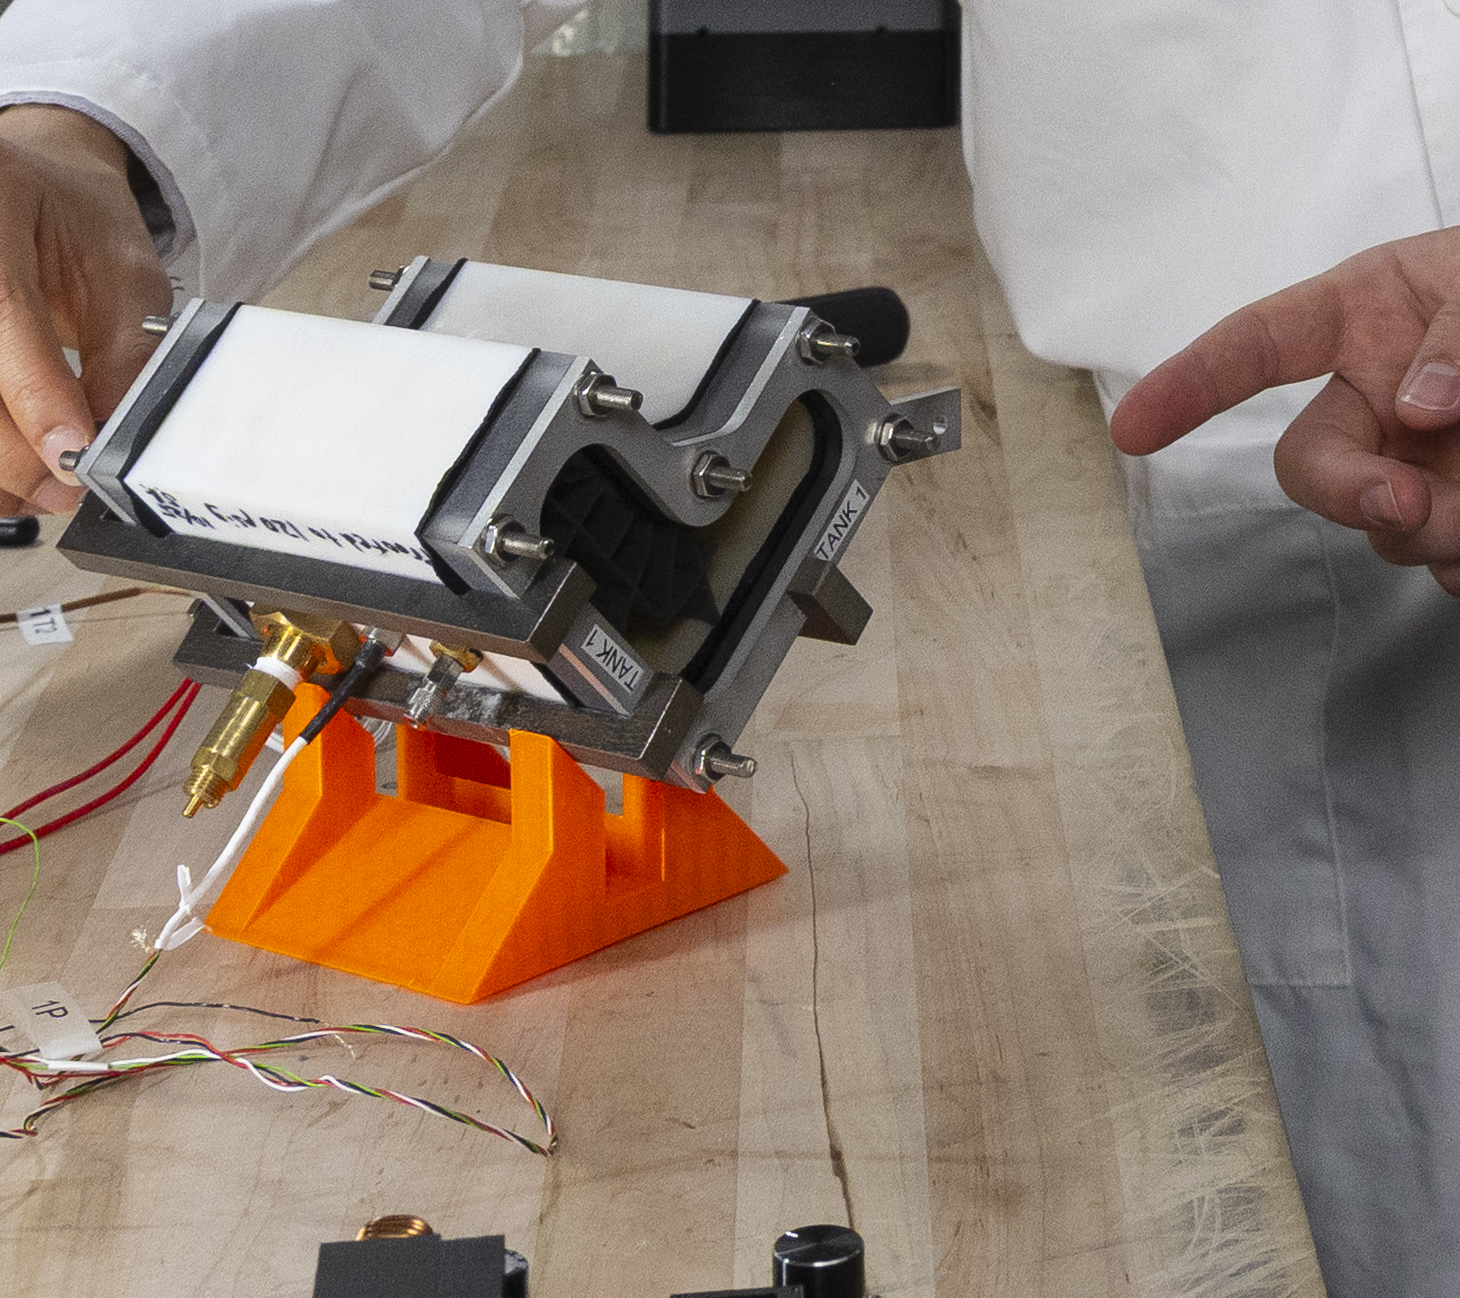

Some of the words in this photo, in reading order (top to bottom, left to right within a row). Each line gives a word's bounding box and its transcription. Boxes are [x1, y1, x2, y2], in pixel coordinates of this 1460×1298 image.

[259, 515, 310, 542] 120
[815, 501, 859, 561] TANK
[854, 486, 868, 500] 1
[584, 629, 599, 647] 1
[594, 637, 642, 693] TANK
[31, 1000, 69, 1018] 1P
